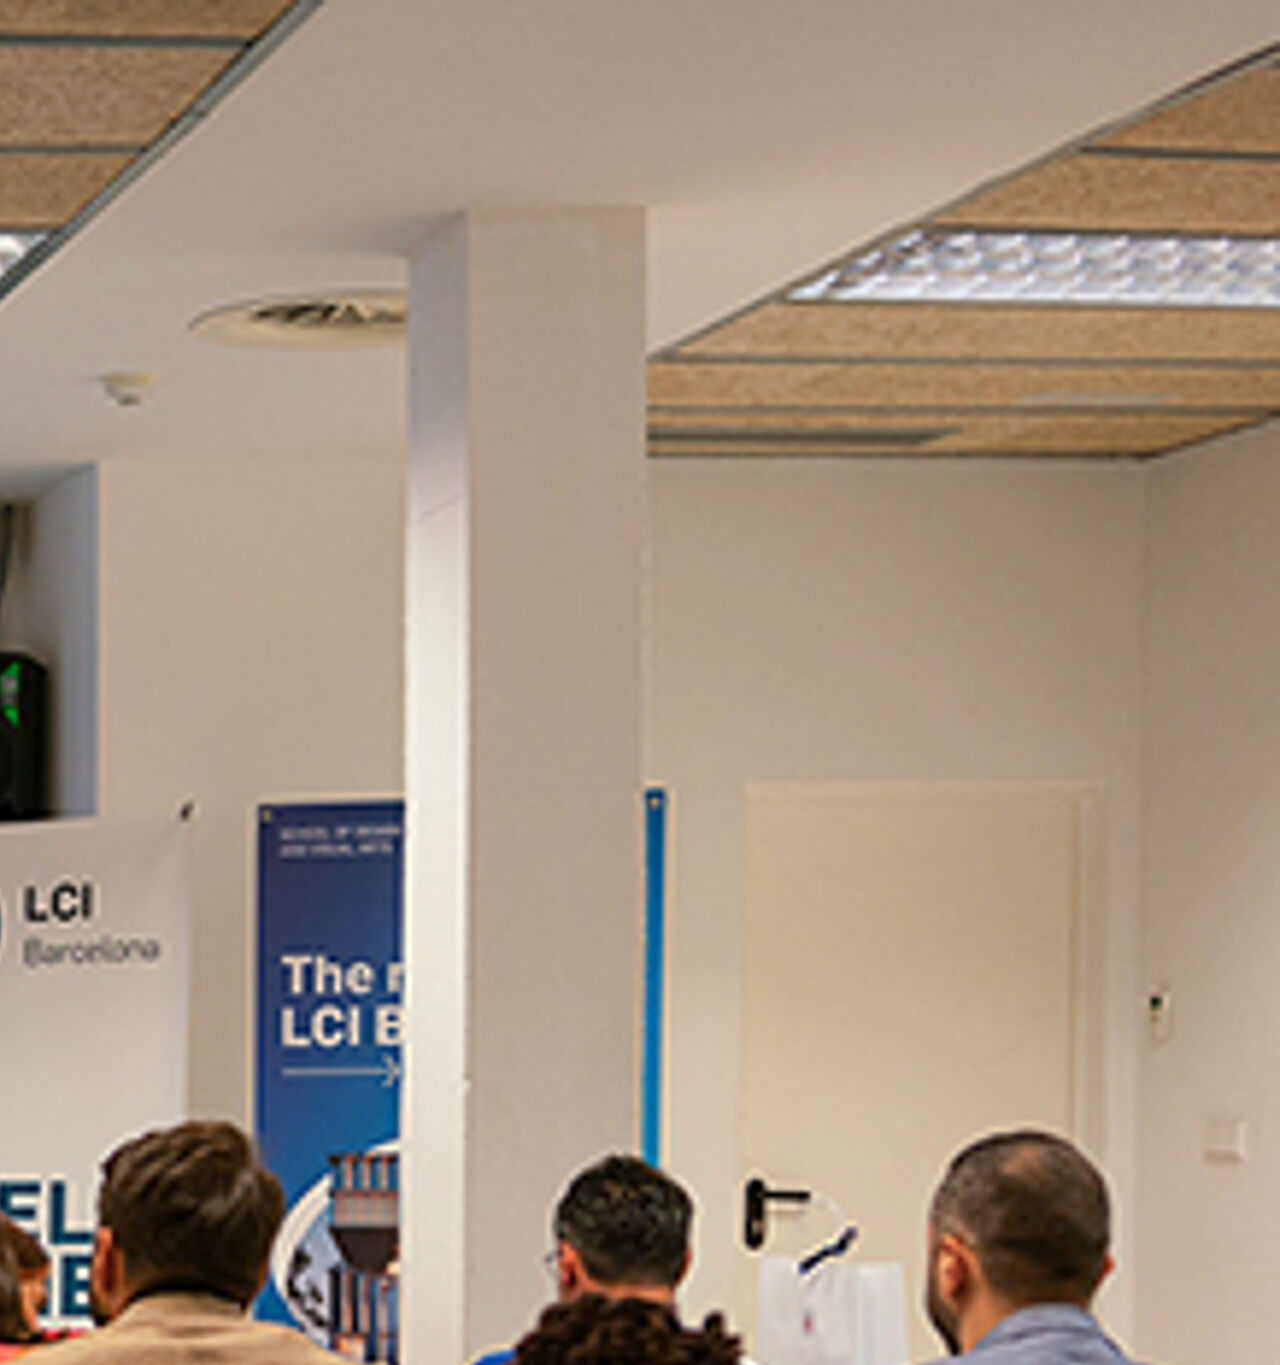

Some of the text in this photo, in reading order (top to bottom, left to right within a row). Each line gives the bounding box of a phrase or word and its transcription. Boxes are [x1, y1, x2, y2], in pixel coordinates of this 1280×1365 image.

[24, 880, 94, 922] LCI
[23, 935, 161, 969] Barcelona
[281, 955, 374, 995] The
[281, 1004, 361, 1047] LCI
